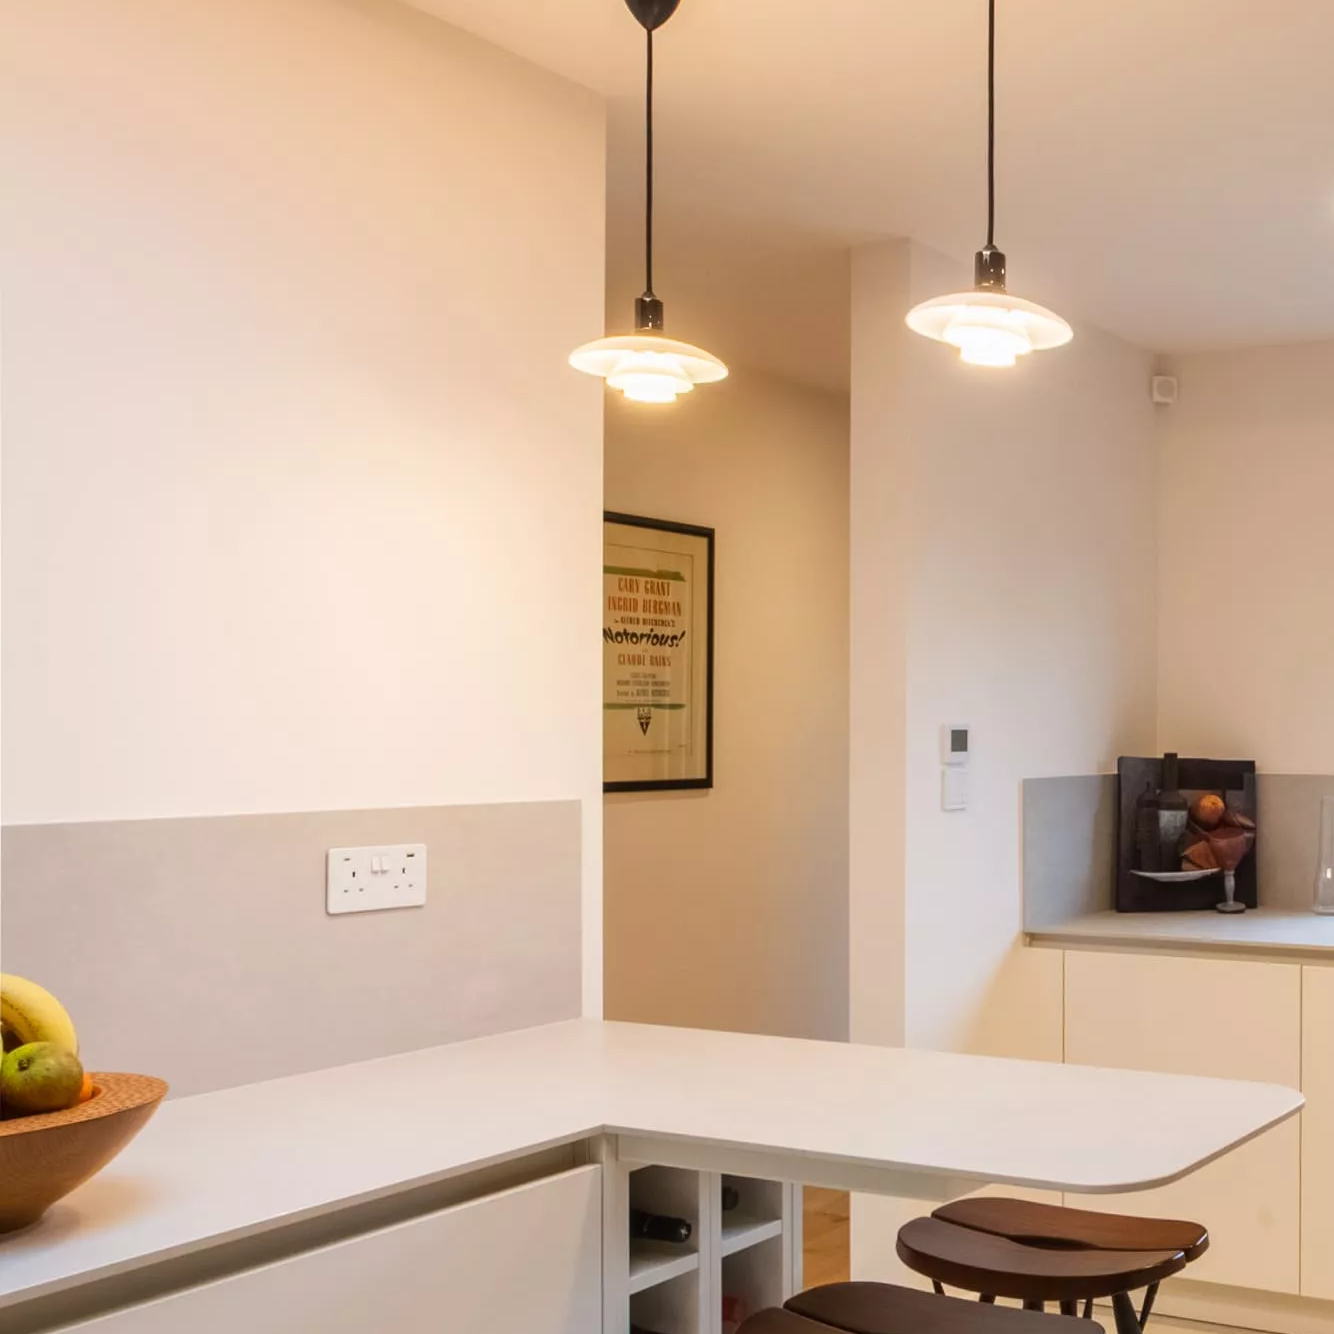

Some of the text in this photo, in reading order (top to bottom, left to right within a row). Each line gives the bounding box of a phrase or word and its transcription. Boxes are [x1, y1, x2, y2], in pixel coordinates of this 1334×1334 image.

[618, 577, 670, 597] CARY GRANT
[608, 595, 681, 616] INGRID BERGMAN
[603, 626, 686, 648] Notorious!
